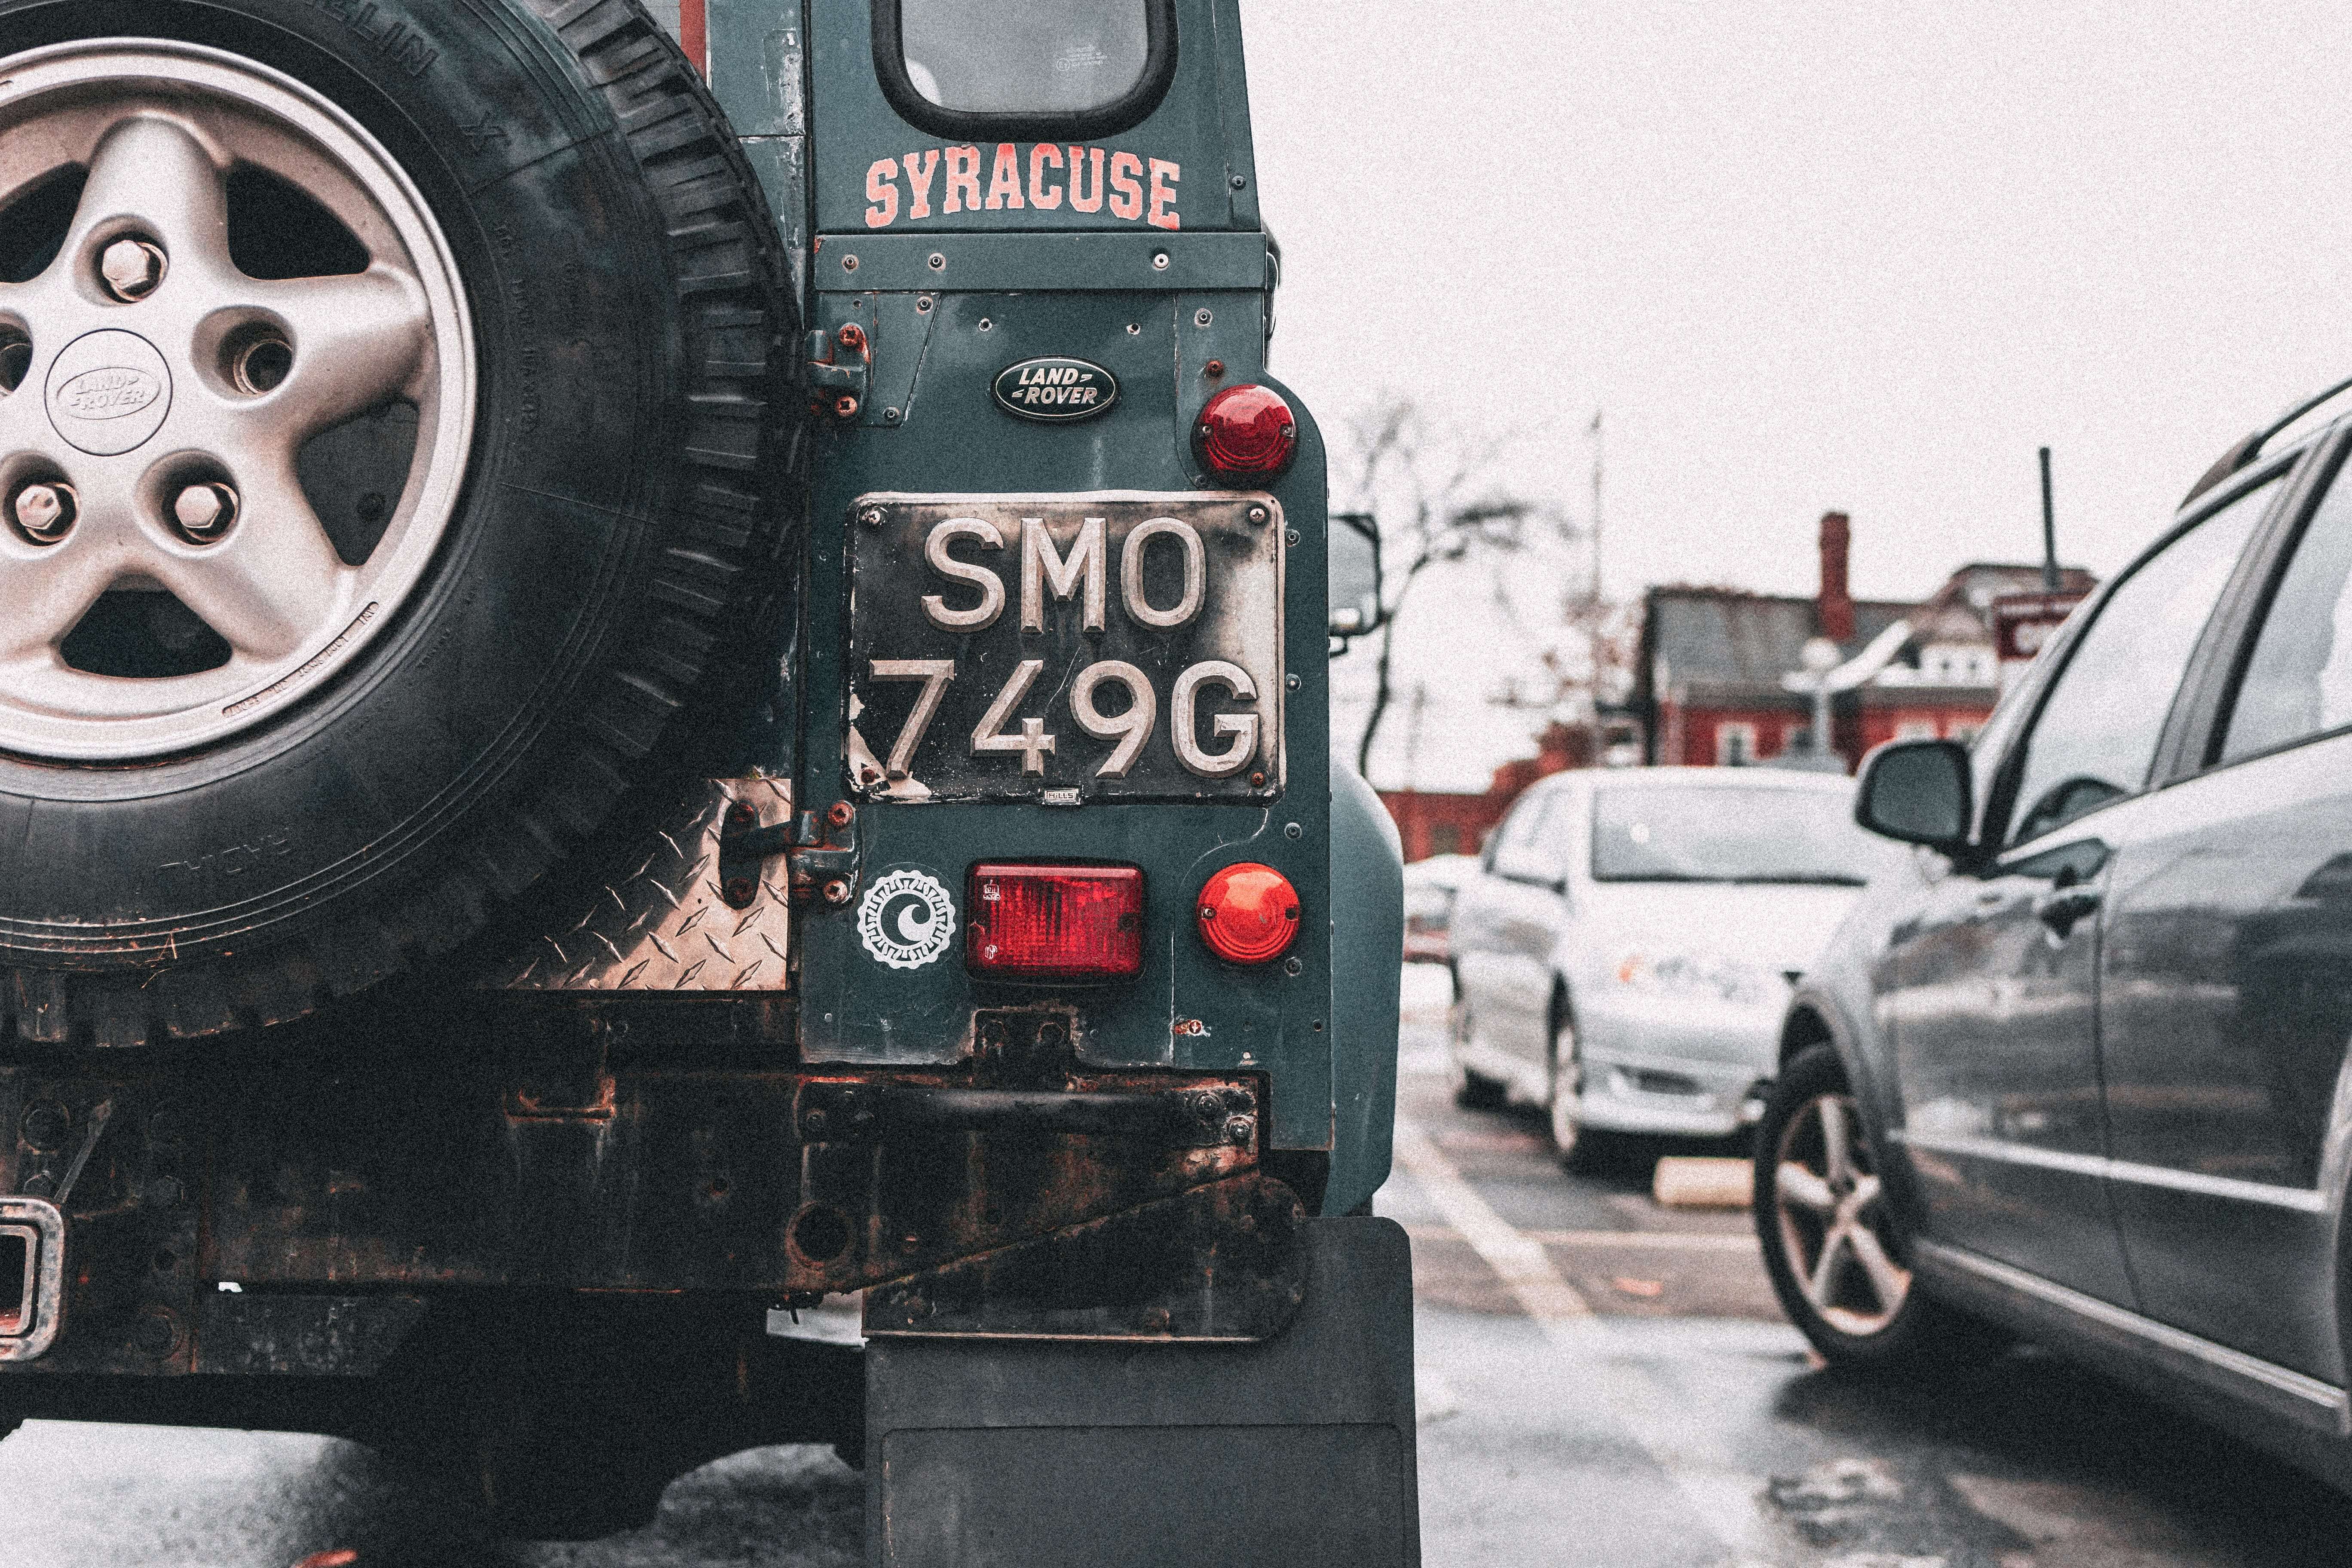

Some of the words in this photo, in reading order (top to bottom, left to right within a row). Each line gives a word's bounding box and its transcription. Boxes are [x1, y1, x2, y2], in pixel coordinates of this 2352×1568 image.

[865, 143, 1180, 230] SYRACUSE
[1019, 368, 1078, 385] LAND
[1024, 387, 1097, 404] ROVER
[921, 517, 1207, 633] SMO
[869, 659, 1259, 778] 749G
